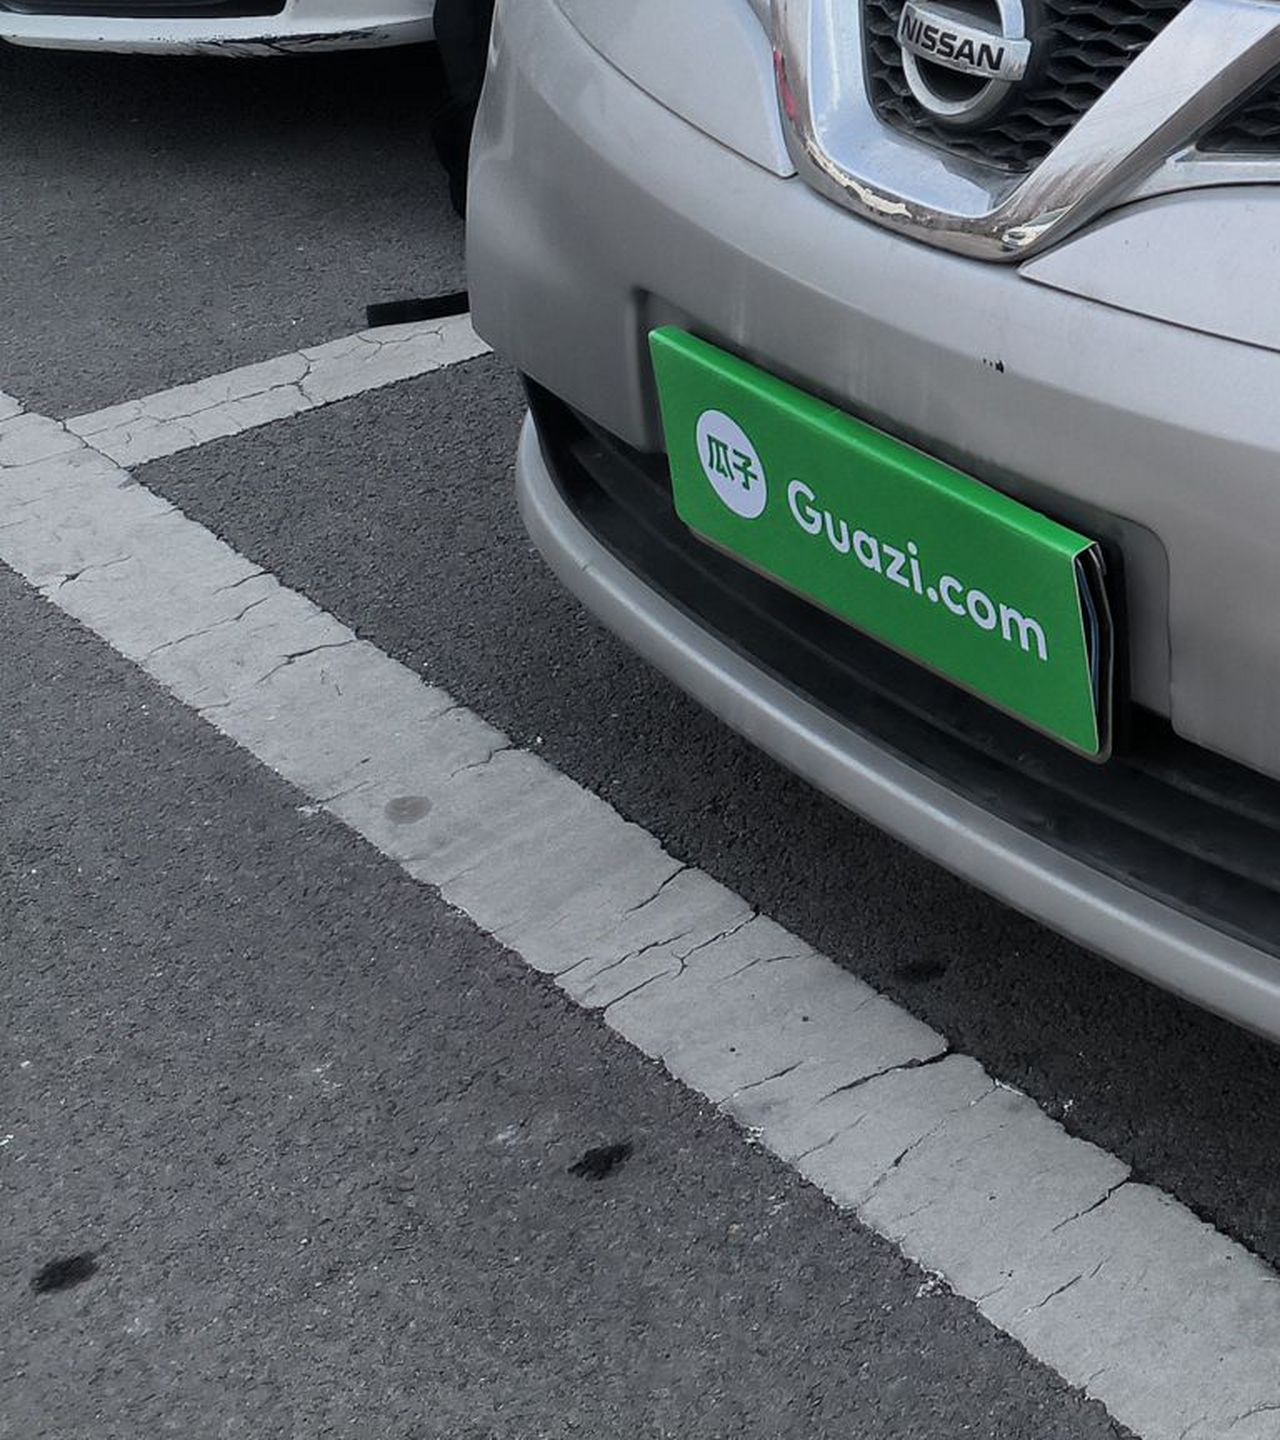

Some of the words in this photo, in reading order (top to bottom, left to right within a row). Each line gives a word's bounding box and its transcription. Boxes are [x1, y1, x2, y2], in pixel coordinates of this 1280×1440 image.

[901, 15, 1005, 71] NISSAN
[706, 433, 759, 491] 瓜子
[786, 479, 1049, 661] Guazi.com
